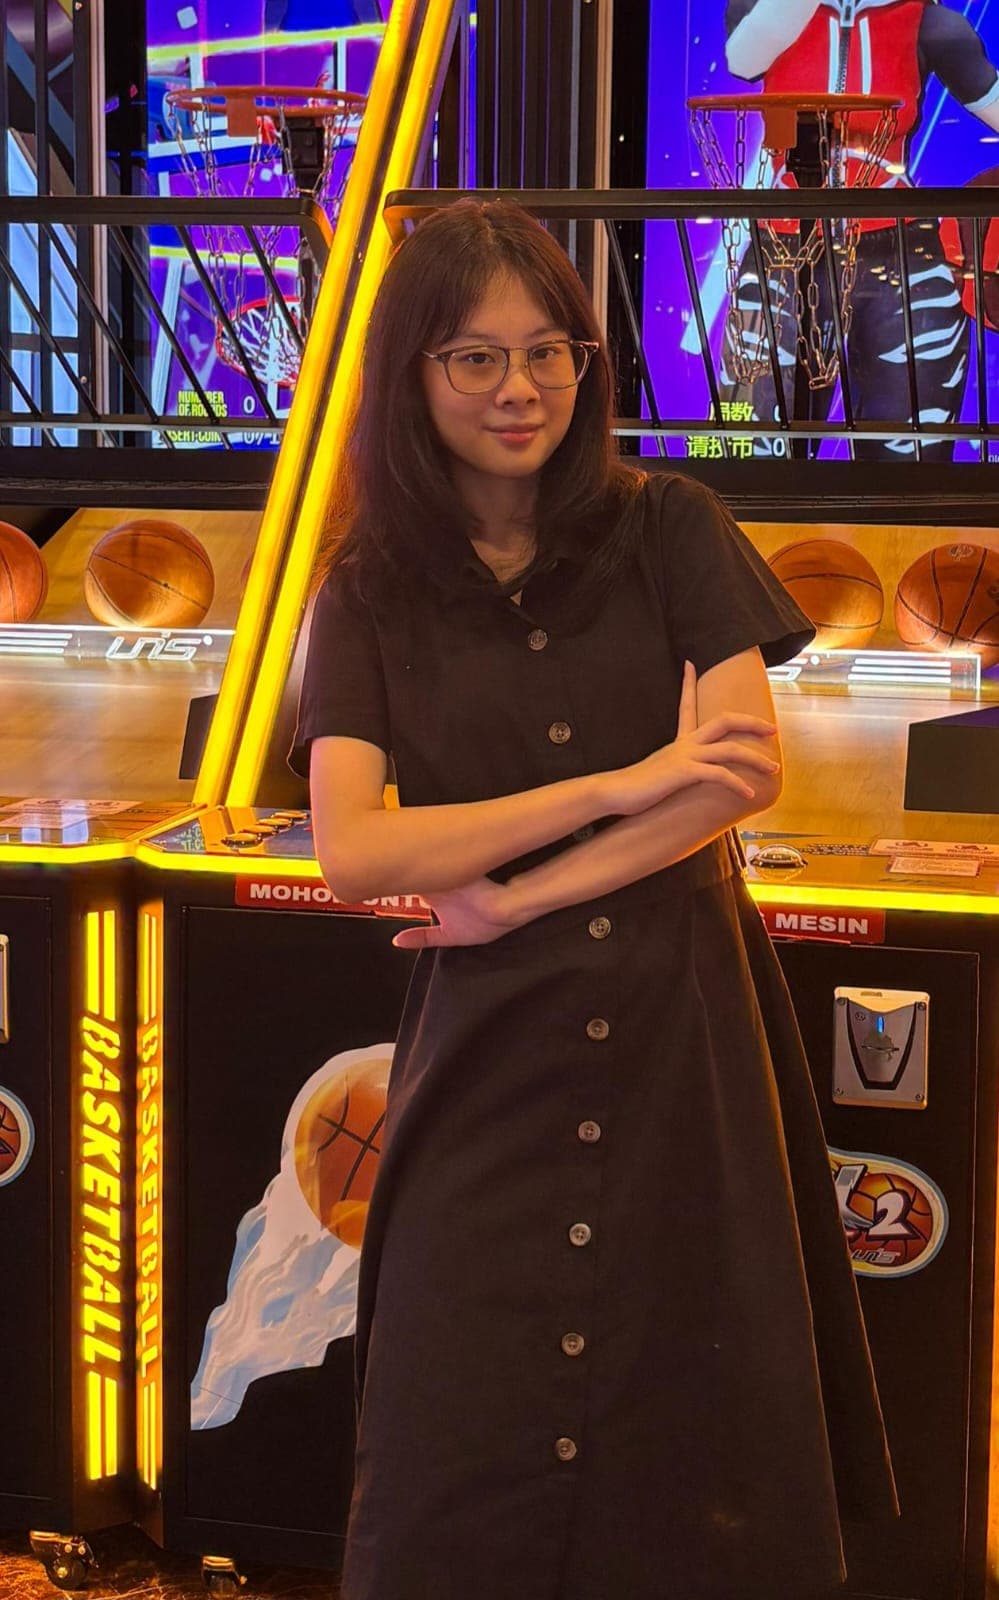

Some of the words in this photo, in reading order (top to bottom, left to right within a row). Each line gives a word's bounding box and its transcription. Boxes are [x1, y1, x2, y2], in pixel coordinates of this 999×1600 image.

[243, 395, 255, 414] 0
[250, 883, 342, 904] MOHO
[776, 912, 868, 935] MESIN
[82, 1016, 121, 1364] BASKETBALL
[141, 1024, 158, 1379] BASKETBALL
